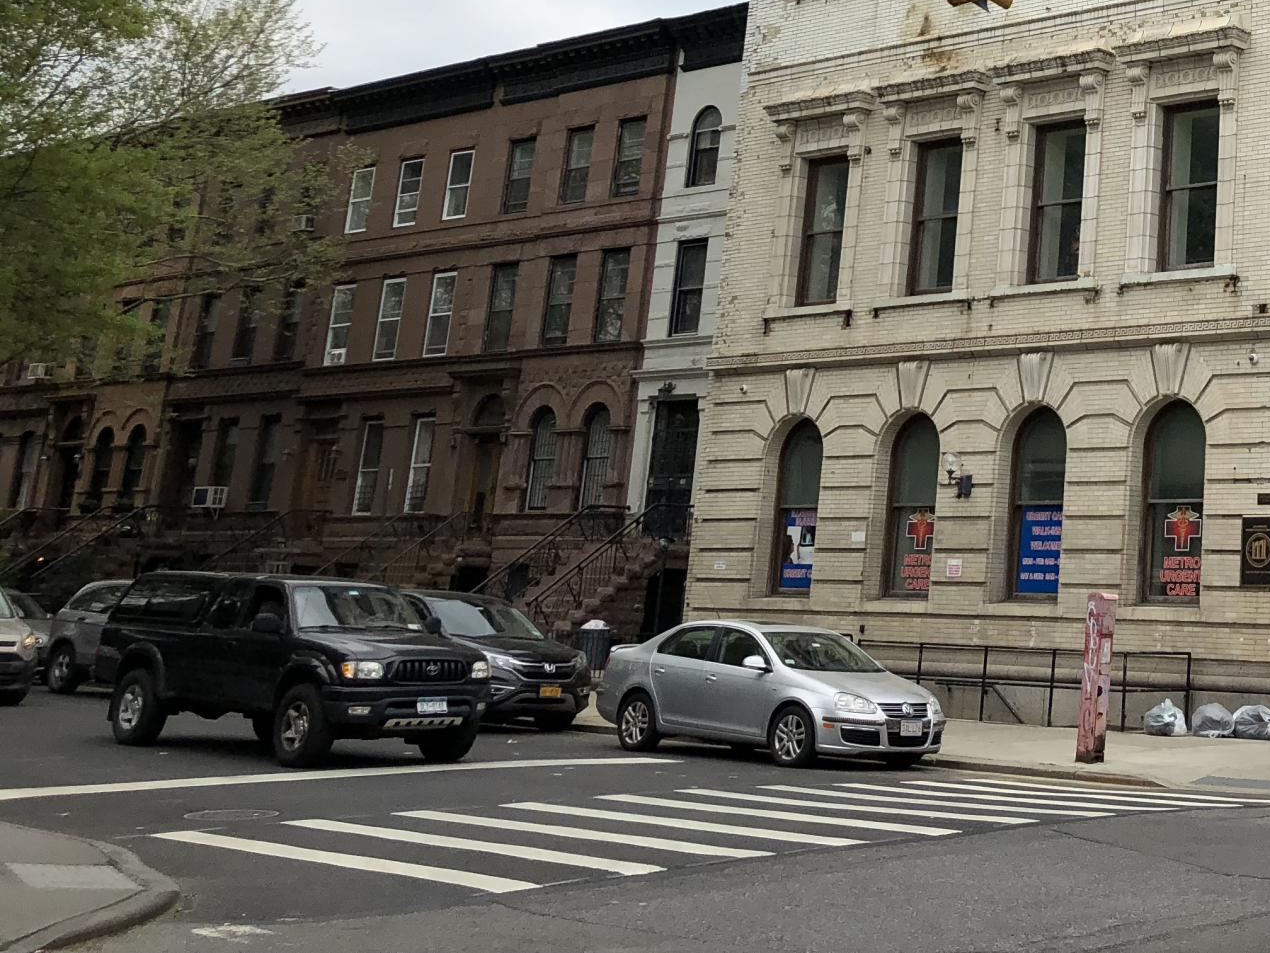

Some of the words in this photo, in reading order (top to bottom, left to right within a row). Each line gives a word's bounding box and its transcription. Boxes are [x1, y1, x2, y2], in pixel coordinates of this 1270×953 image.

[1163, 556, 1201, 568] METRO
[901, 566, 931, 577] URGEN
[1160, 569, 1200, 582] URGENT
[1166, 583, 1196, 596] CARE
